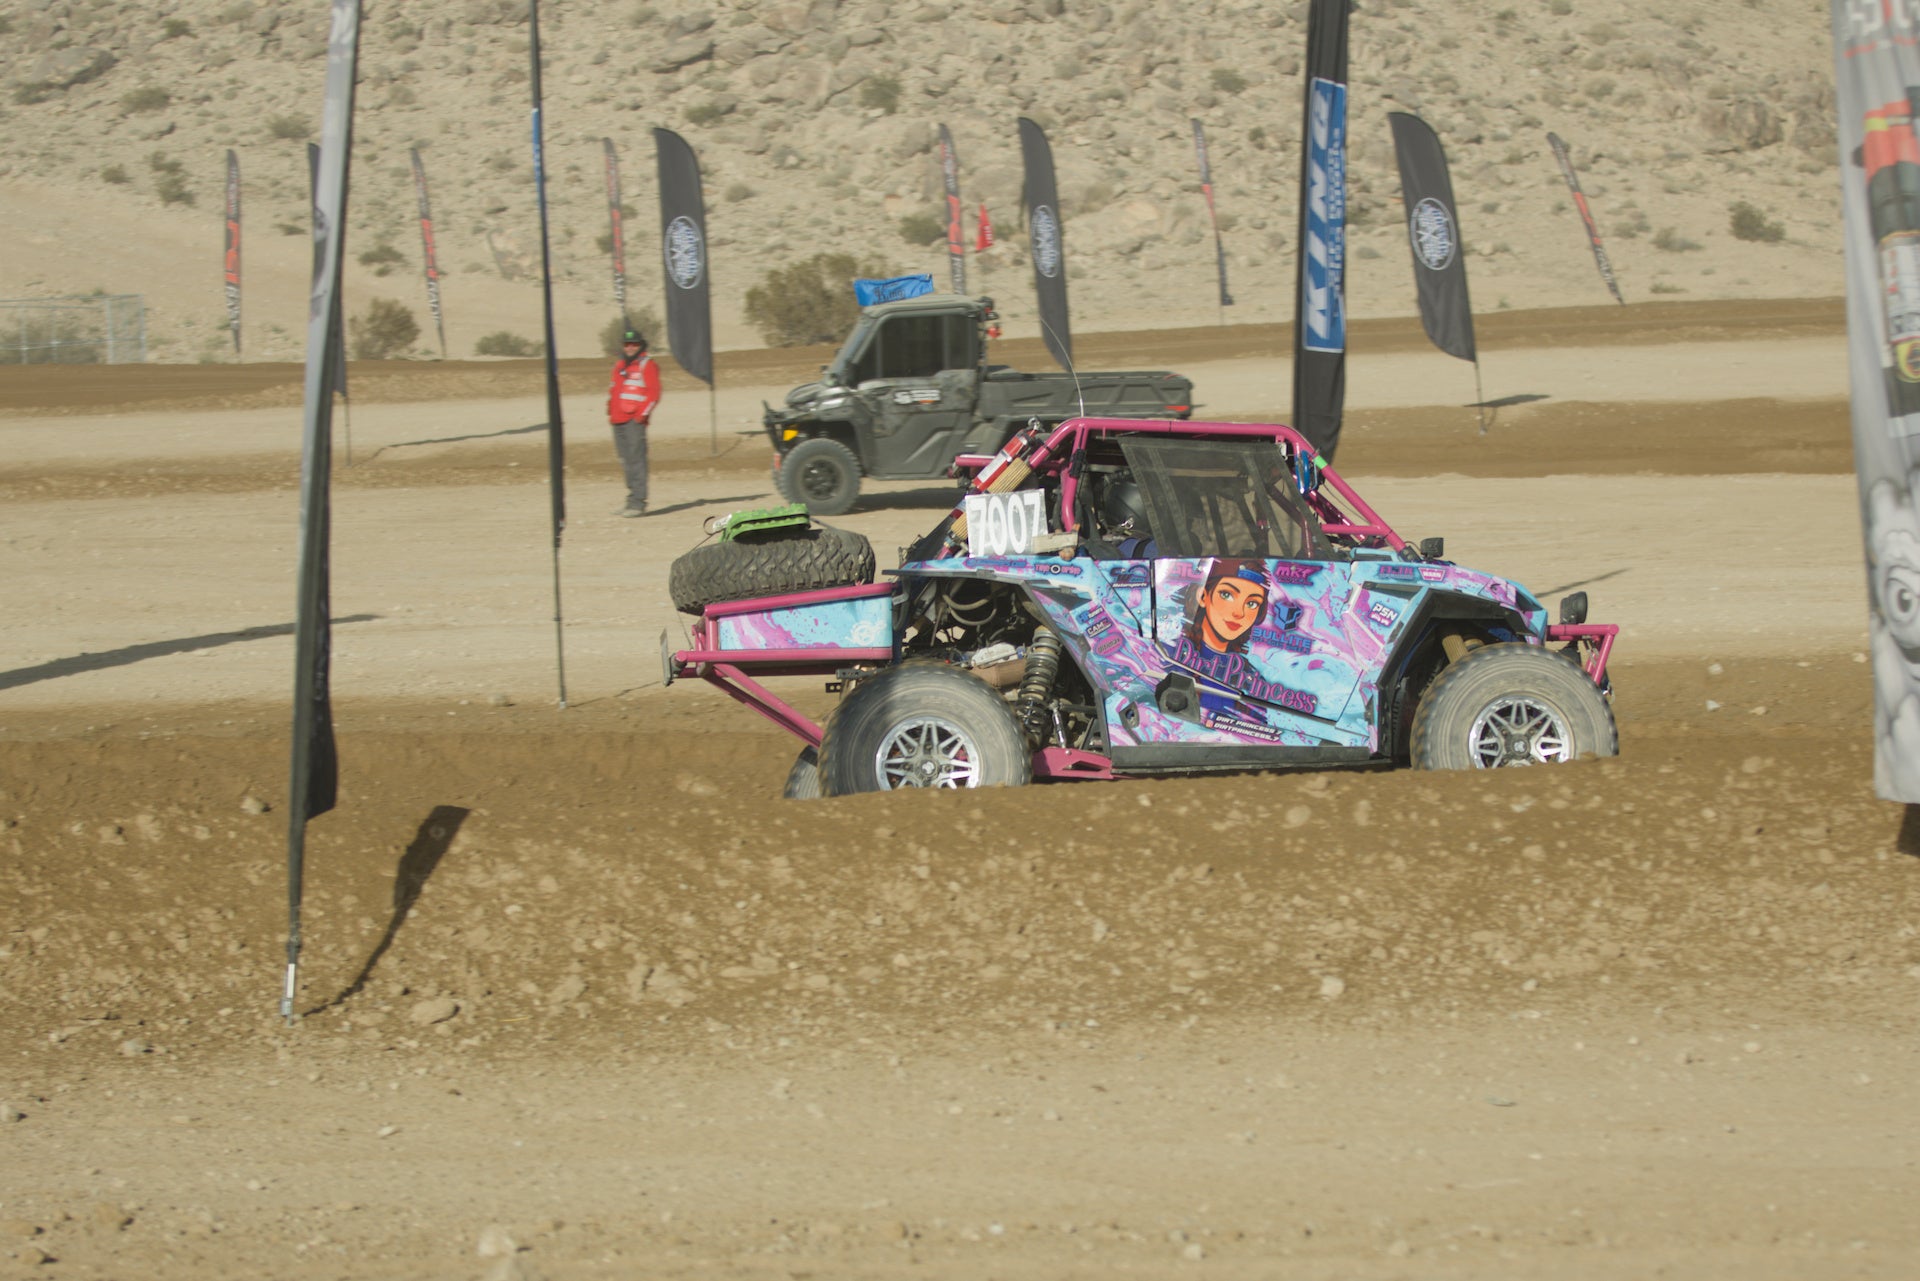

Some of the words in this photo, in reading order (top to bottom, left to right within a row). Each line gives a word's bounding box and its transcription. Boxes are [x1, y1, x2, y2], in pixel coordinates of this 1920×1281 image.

[1308, 89, 1330, 339] KING
[969, 491, 1041, 557] 7007
[1372, 602, 1398, 621] PSN
[1173, 638, 1220, 677] Dirt
[1223, 653, 1318, 714] Princess
[1215, 716, 1235, 725] DIRT
[1236, 720, 1274, 734] PRINCESS
